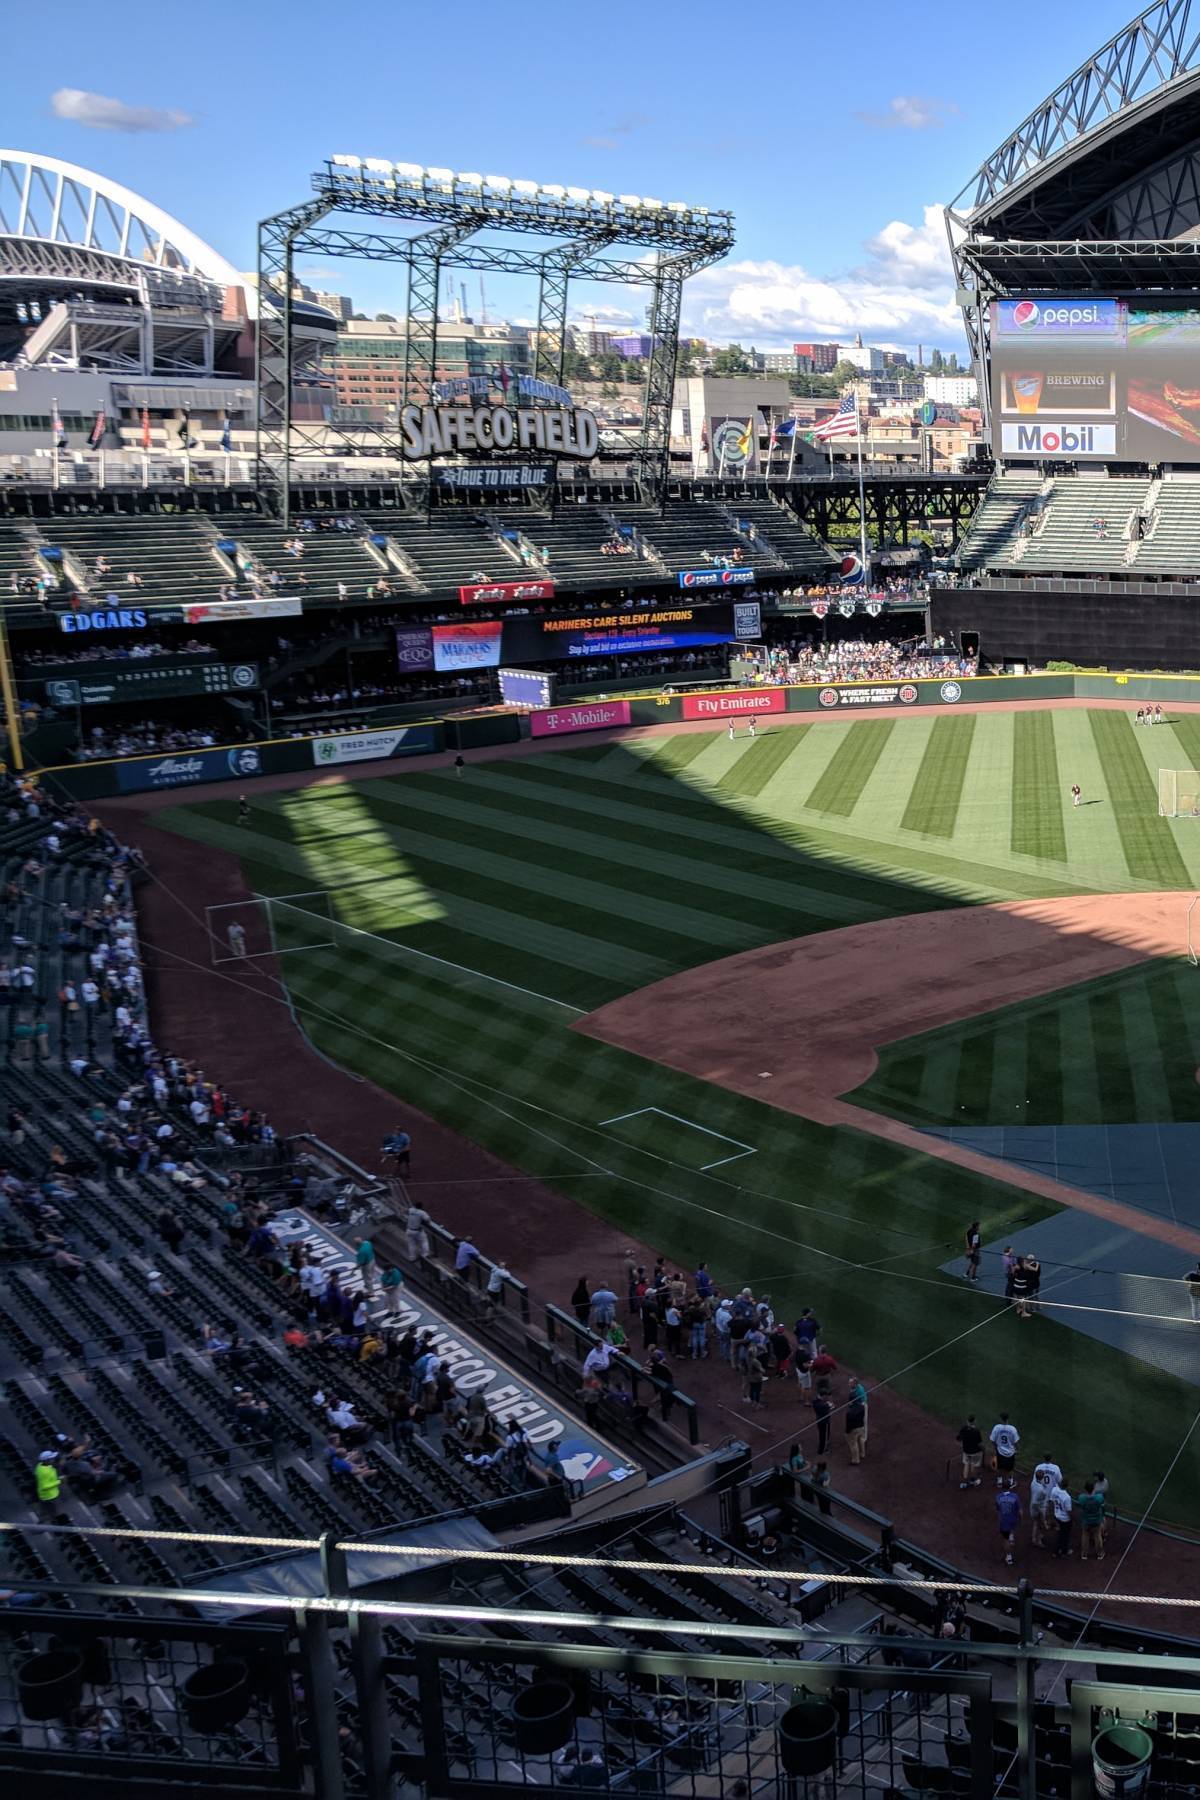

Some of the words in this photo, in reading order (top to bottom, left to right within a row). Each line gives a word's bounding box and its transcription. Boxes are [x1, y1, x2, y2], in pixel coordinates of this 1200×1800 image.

[1044, 305, 1098, 326] pepsi
[1046, 376, 1105, 385] BREWING
[401, 404, 514, 459] SAFECO
[516, 407, 599, 458] FIELD
[1017, 426, 1094, 451] Mobil
[455, 469, 483, 486] TRUE
[485, 470, 498, 485] TO
[499, 469, 519, 485] THE
[521, 467, 547, 485] BLUE
[696, 574, 717, 584] pepsi
[733, 572, 754, 582] pepsi
[736, 607, 757, 617] BUILT
[60, 611, 148, 633] EDGARS
[544, 618, 593, 632] MARINERS
[593, 616, 618, 627] CARE
[619, 614, 650, 625] SILENT
[651, 611, 693, 622] AUCTIONS
[737, 627, 759, 635] TOUGH
[441, 643, 491, 656] MARINERS
[840, 689, 870, 697] WHERE
[871, 687, 898, 696] FRESH
[871, 694, 896, 702] MEET
[656, 697, 671, 706] 376
[698, 700, 718, 713] Fly
[720, 696, 771, 711] Emirates
[341, 740, 364, 750] FRED
[366, 737, 396, 746] HUTCH
[147, 757, 204, 776] Alaska
[153, 773, 200, 784] AIRLINES
[483, 1384, 566, 1444] FIELD
[1001, 1435, 1008, 1444] 9
